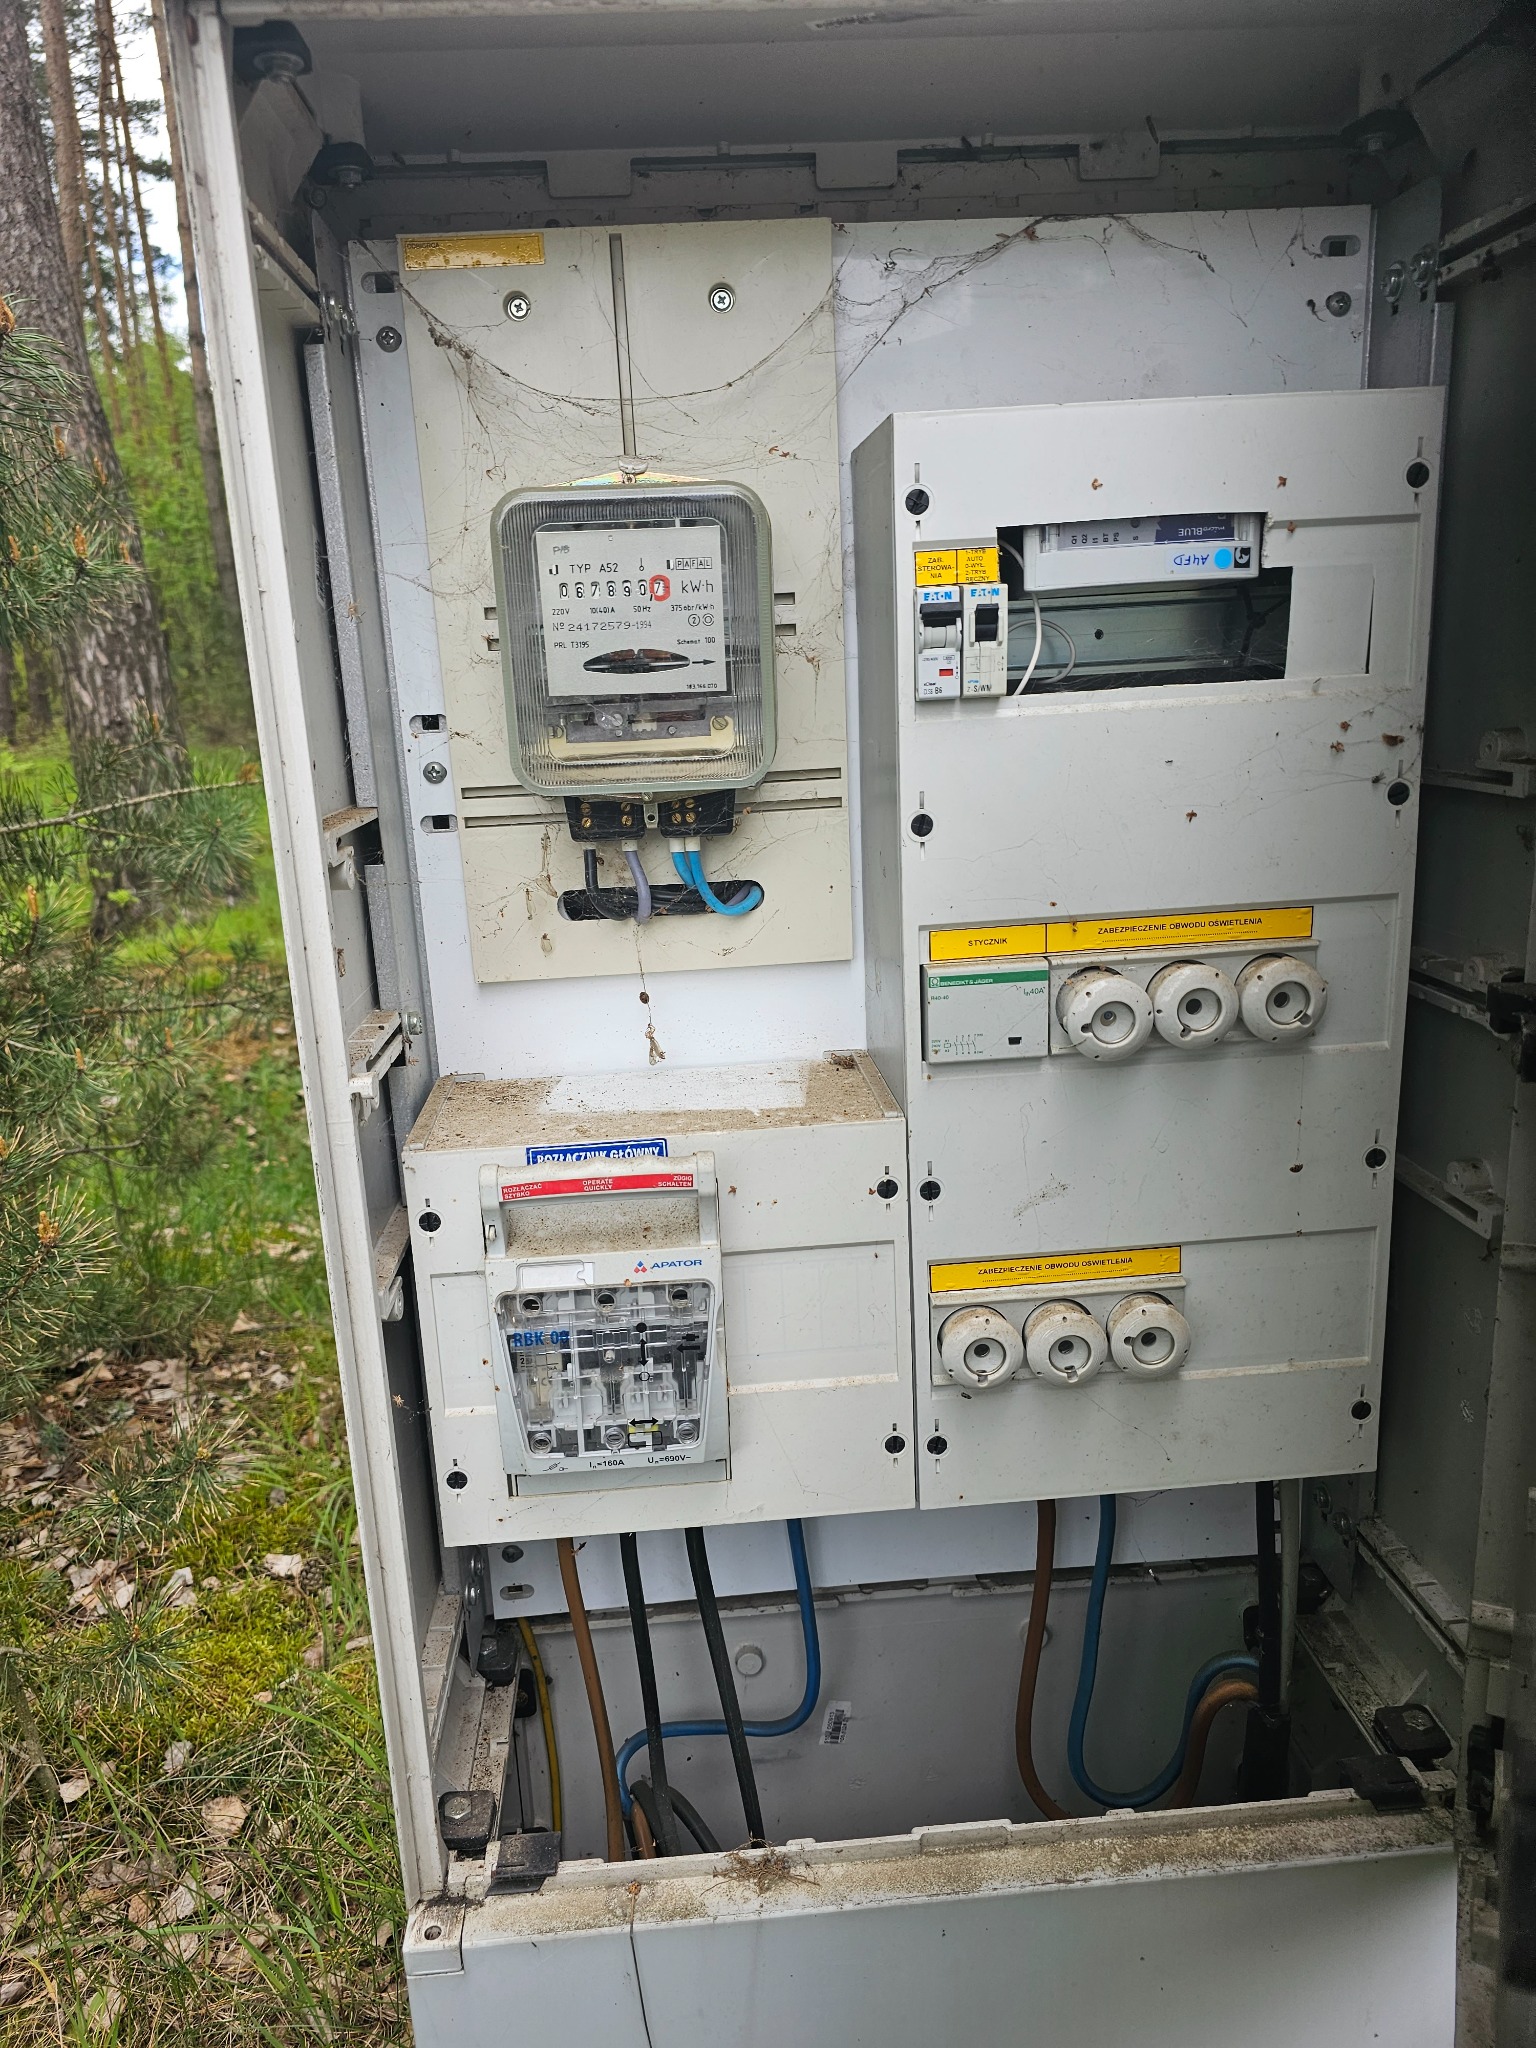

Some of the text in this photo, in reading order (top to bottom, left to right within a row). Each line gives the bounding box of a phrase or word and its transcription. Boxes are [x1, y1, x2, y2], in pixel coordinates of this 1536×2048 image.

[1178, 526, 1225, 537] microBLUE
[1103, 533, 1109, 542] BT
[569, 562, 619, 574] TYP A52
[676, 558, 711, 569] PAFAL
[917, 564, 955, 572] STEROWA-
[551, 608, 570, 616] 220V
[704, 636, 716, 644] 100
[1097, 917, 1263, 935] ZABEZPIECZENIE OBWODU OŚWIETLENIA
[967, 937, 1008, 947] STYCZNIK
[582, 1177, 614, 1186] OPERATE
[502, 1182, 543, 1194] ROZŁĄCZAĆ
[583, 1184, 613, 1192] QUICKLY
[504, 1191, 530, 1200] SZYBKO
[651, 1259, 703, 1269] APATOR
[977, 1264, 1043, 1275] ZABEZPIECZENIE
[1044, 1261, 1080, 1270] OBWODU
[512, 1330, 545, 1348] RBK
